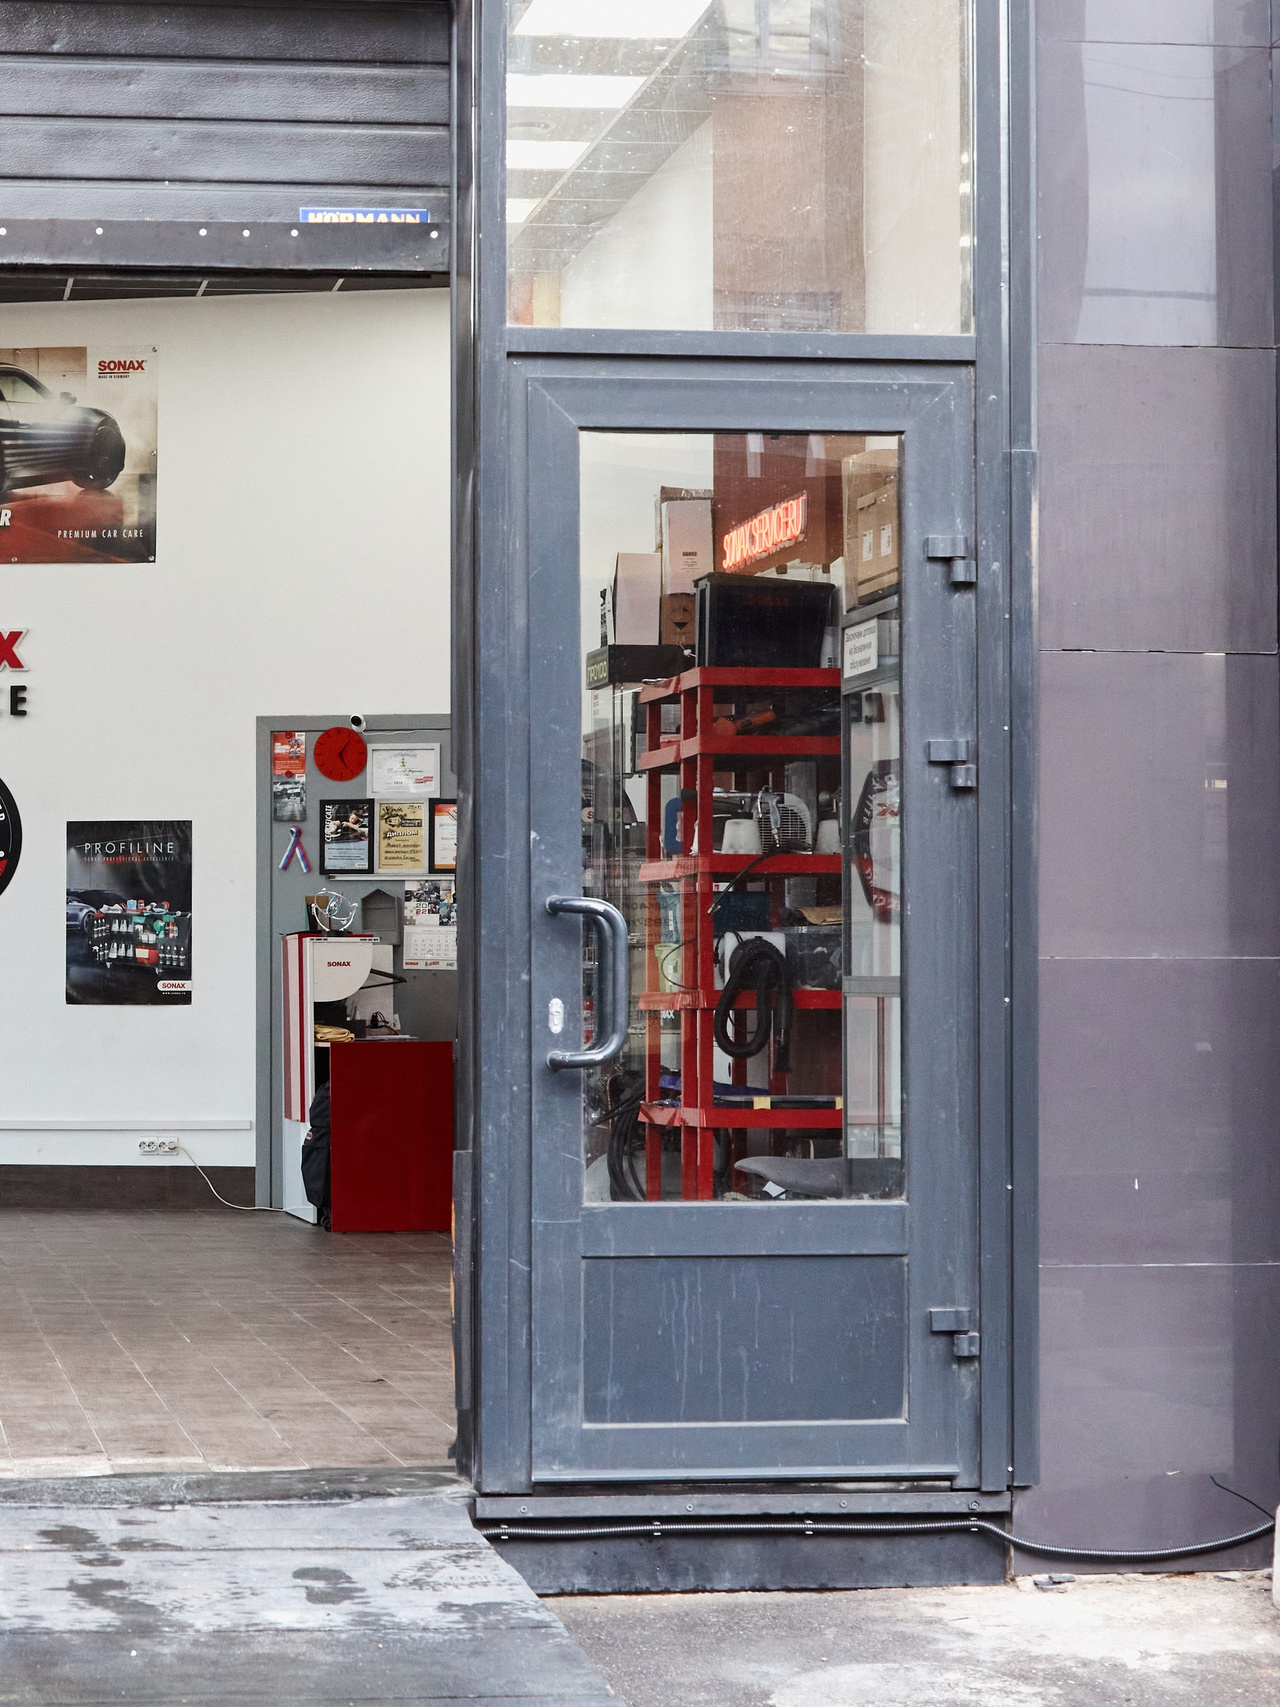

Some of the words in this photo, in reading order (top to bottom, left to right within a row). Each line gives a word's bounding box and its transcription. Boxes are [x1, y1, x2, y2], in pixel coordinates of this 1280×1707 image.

[98, 360, 145, 371] SONAX
[57, 530, 98, 539] PREMIUM
[102, 530, 118, 538] CAR
[123, 529, 144, 538] CARE
[84, 842, 174, 854] PROFILINE
